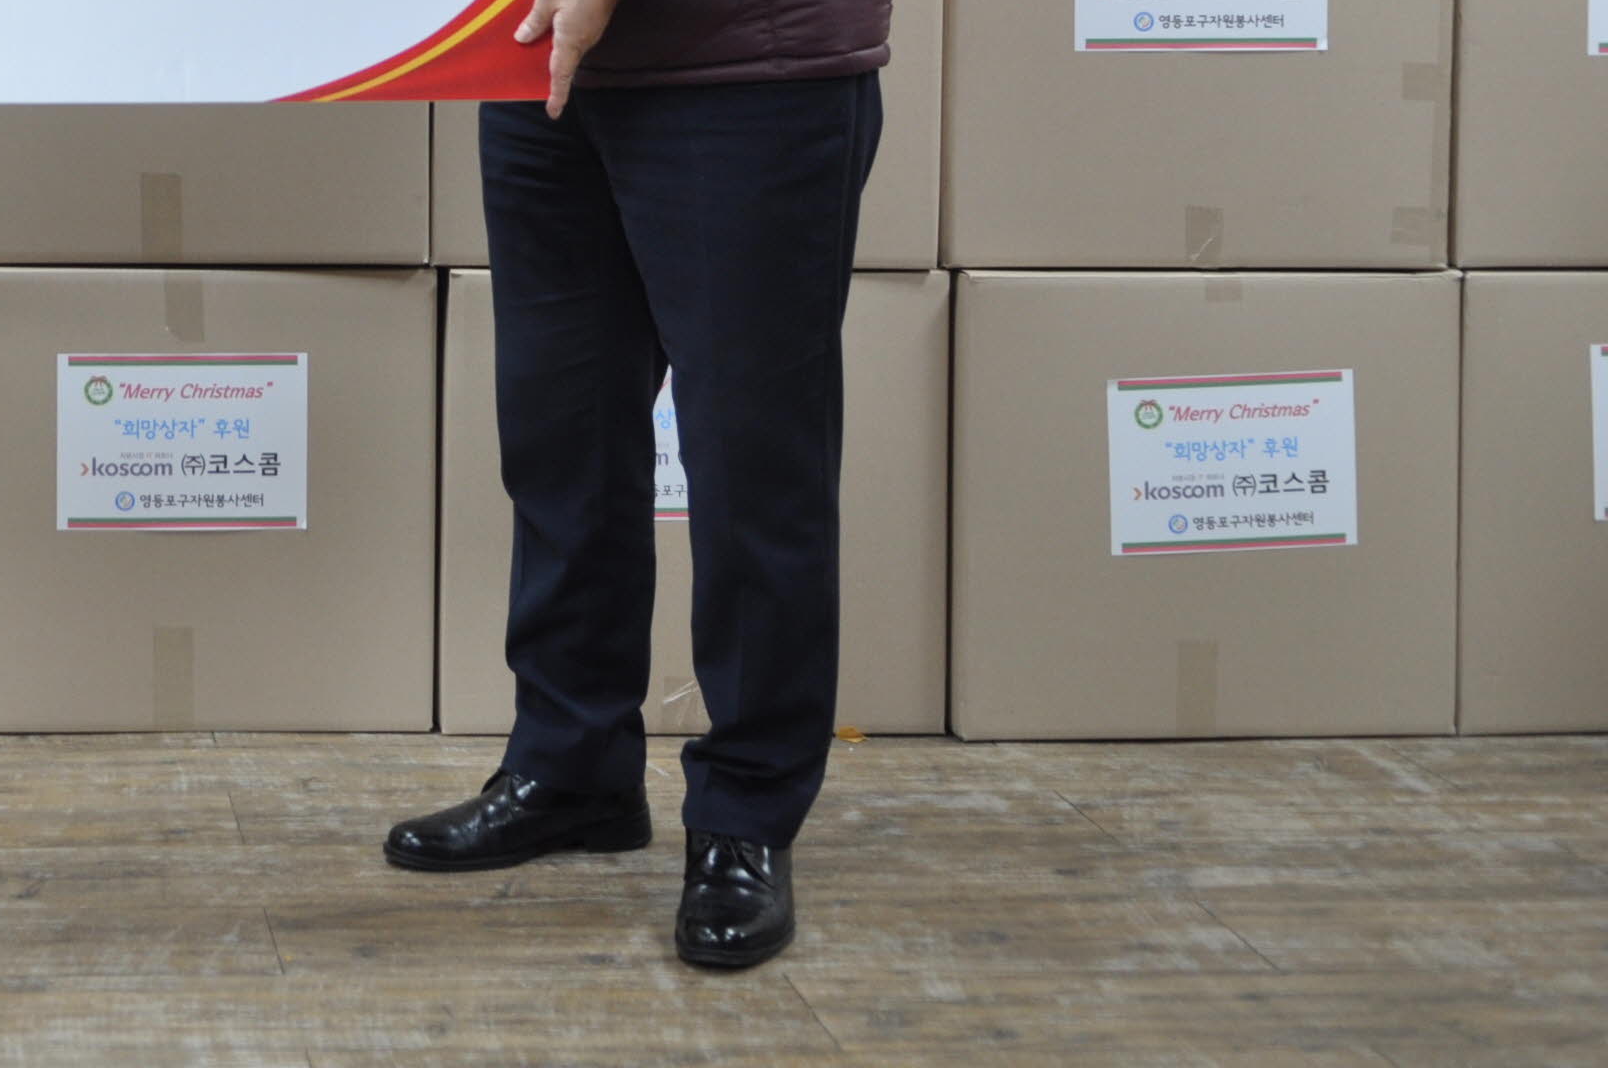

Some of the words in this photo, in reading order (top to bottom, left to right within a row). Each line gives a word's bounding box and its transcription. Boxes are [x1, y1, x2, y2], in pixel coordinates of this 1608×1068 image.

[1158, 14, 1285, 29] 영등포구자원봉사센터
[213, 419, 250, 440] 후원
[1262, 436, 1299, 459] 후원
[91, 457, 173, 477] koscom
[139, 493, 264, 508] 영등포구자원봉사센터
[1144, 481, 1225, 500] koscom
[1192, 511, 1314, 531] 영등포구자원봉사센터
